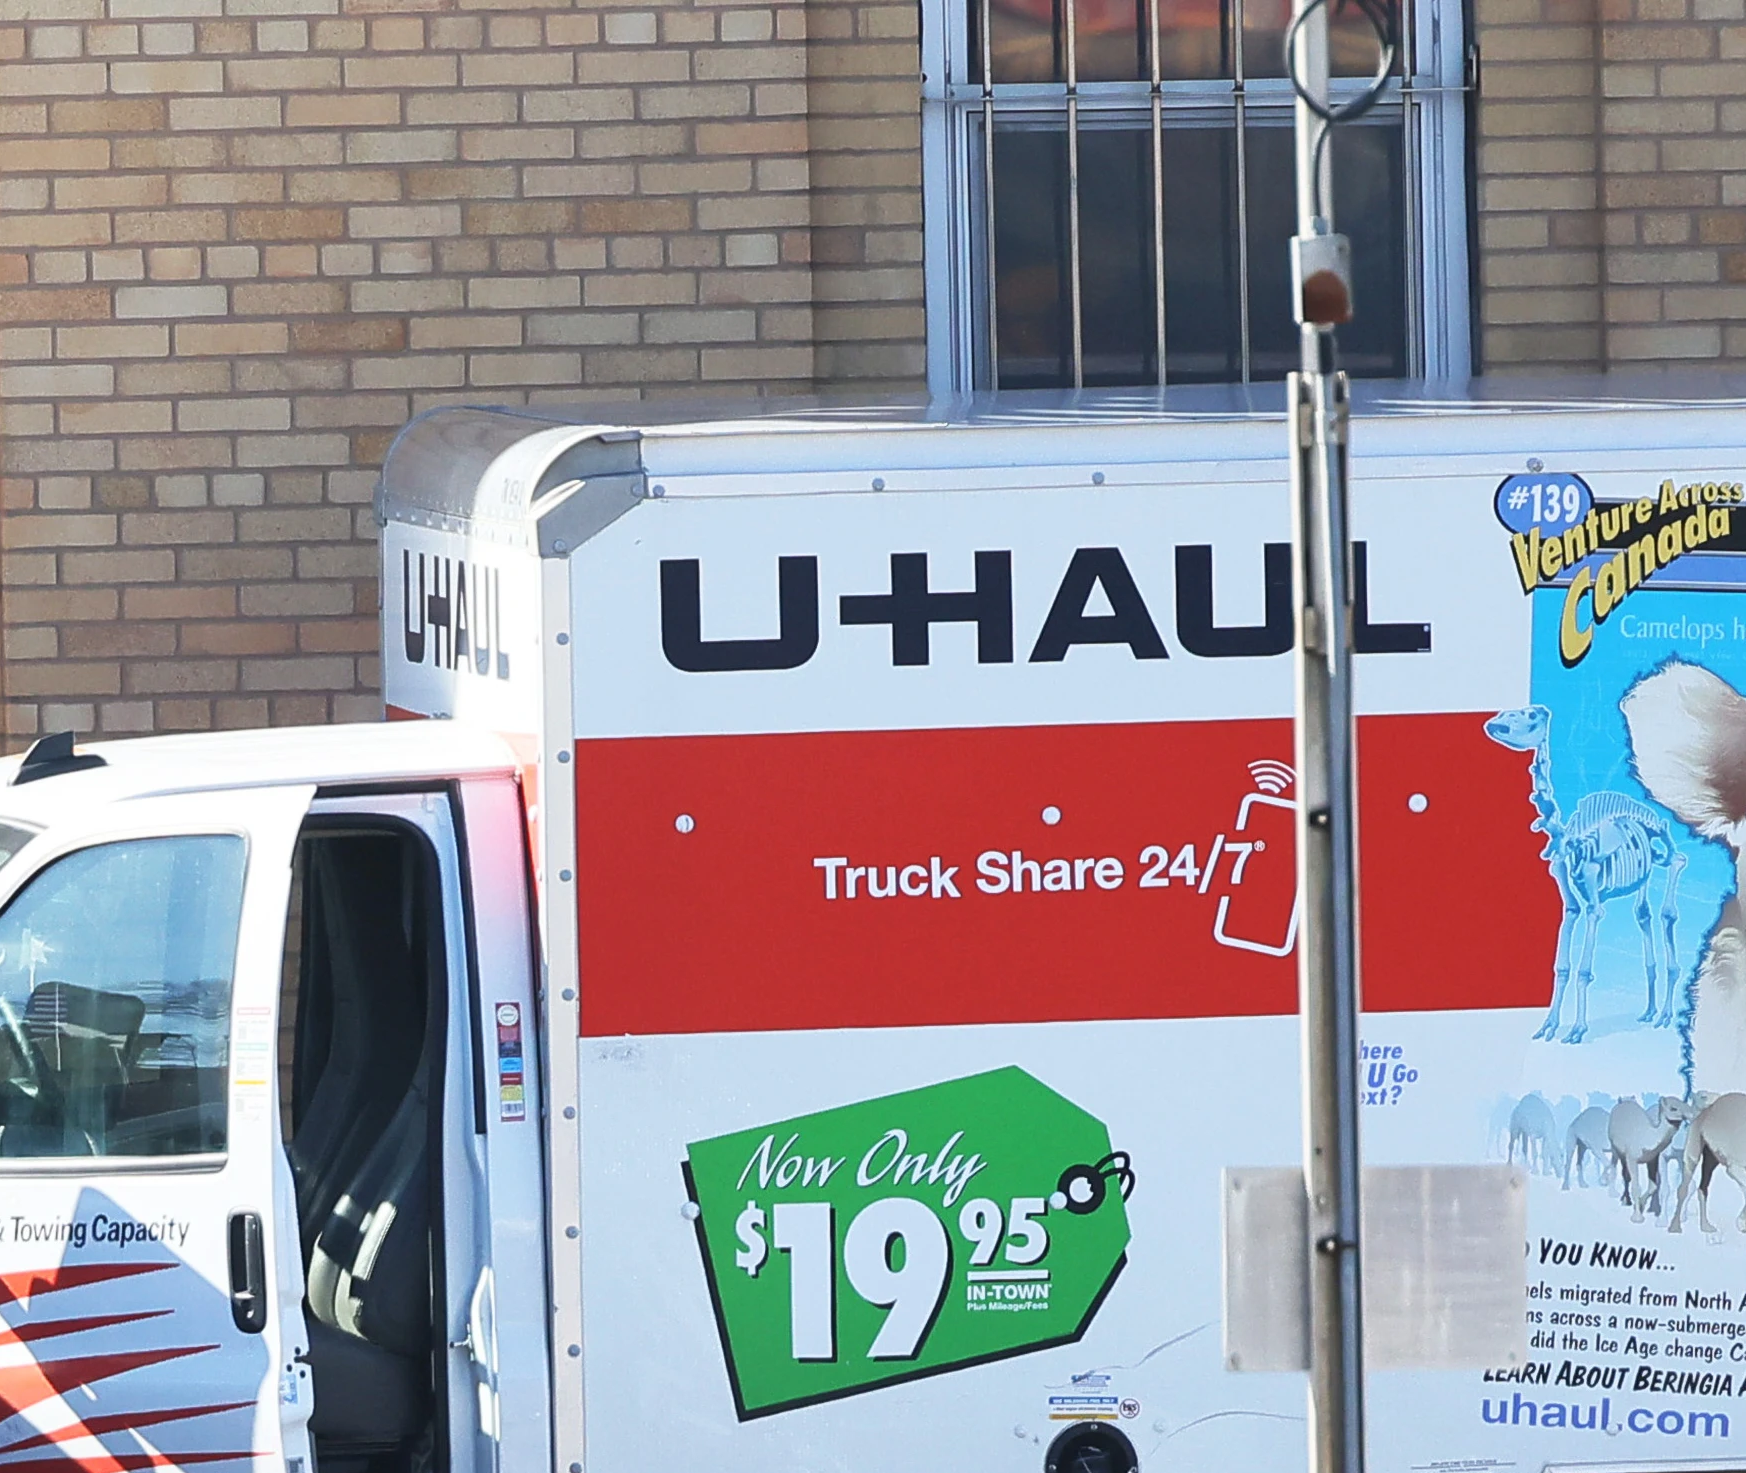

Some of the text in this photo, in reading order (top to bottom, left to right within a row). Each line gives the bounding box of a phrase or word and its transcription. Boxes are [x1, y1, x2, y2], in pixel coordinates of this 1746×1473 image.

[1508, 483, 1581, 524] #139
[1512, 479, 1744, 594] Venture Across
[403, 549, 510, 681] U-HAUL
[1620, 614, 1725, 648] Camelops
[813, 853, 961, 900] Truck
[976, 848, 1123, 895] Share
[1359, 1040, 1403, 1059] here
[1368, 1063, 1418, 1088] U Go
[1360, 1085, 1402, 1105] xt?
[737, 1128, 988, 1209] Now Only
[10, 1215, 86, 1252] Towing
[92, 1212, 193, 1249] Capacity
[1539, 1237, 1584, 1267] YOU
[967, 1303, 986, 1311] Plus
[1559, 1283, 1631, 1307] migrated
[1638, 1286, 1678, 1307] from
[1685, 1289, 1732, 1312] North
[1549, 1310, 1601, 1328] across
[1608, 1316, 1617, 1328] a
[1530, 1331, 1554, 1350] did
[1562, 1333, 1588, 1351] the
[1595, 1335, 1618, 1353] Ice
[1624, 1336, 1658, 1359] Age
[1665, 1339, 1723, 1362] change
[1555, 1361, 1628, 1390] ABOUT
[1633, 1365, 1732, 1397] BERINGIA
[1482, 1393, 1729, 1437] uhaul.com
